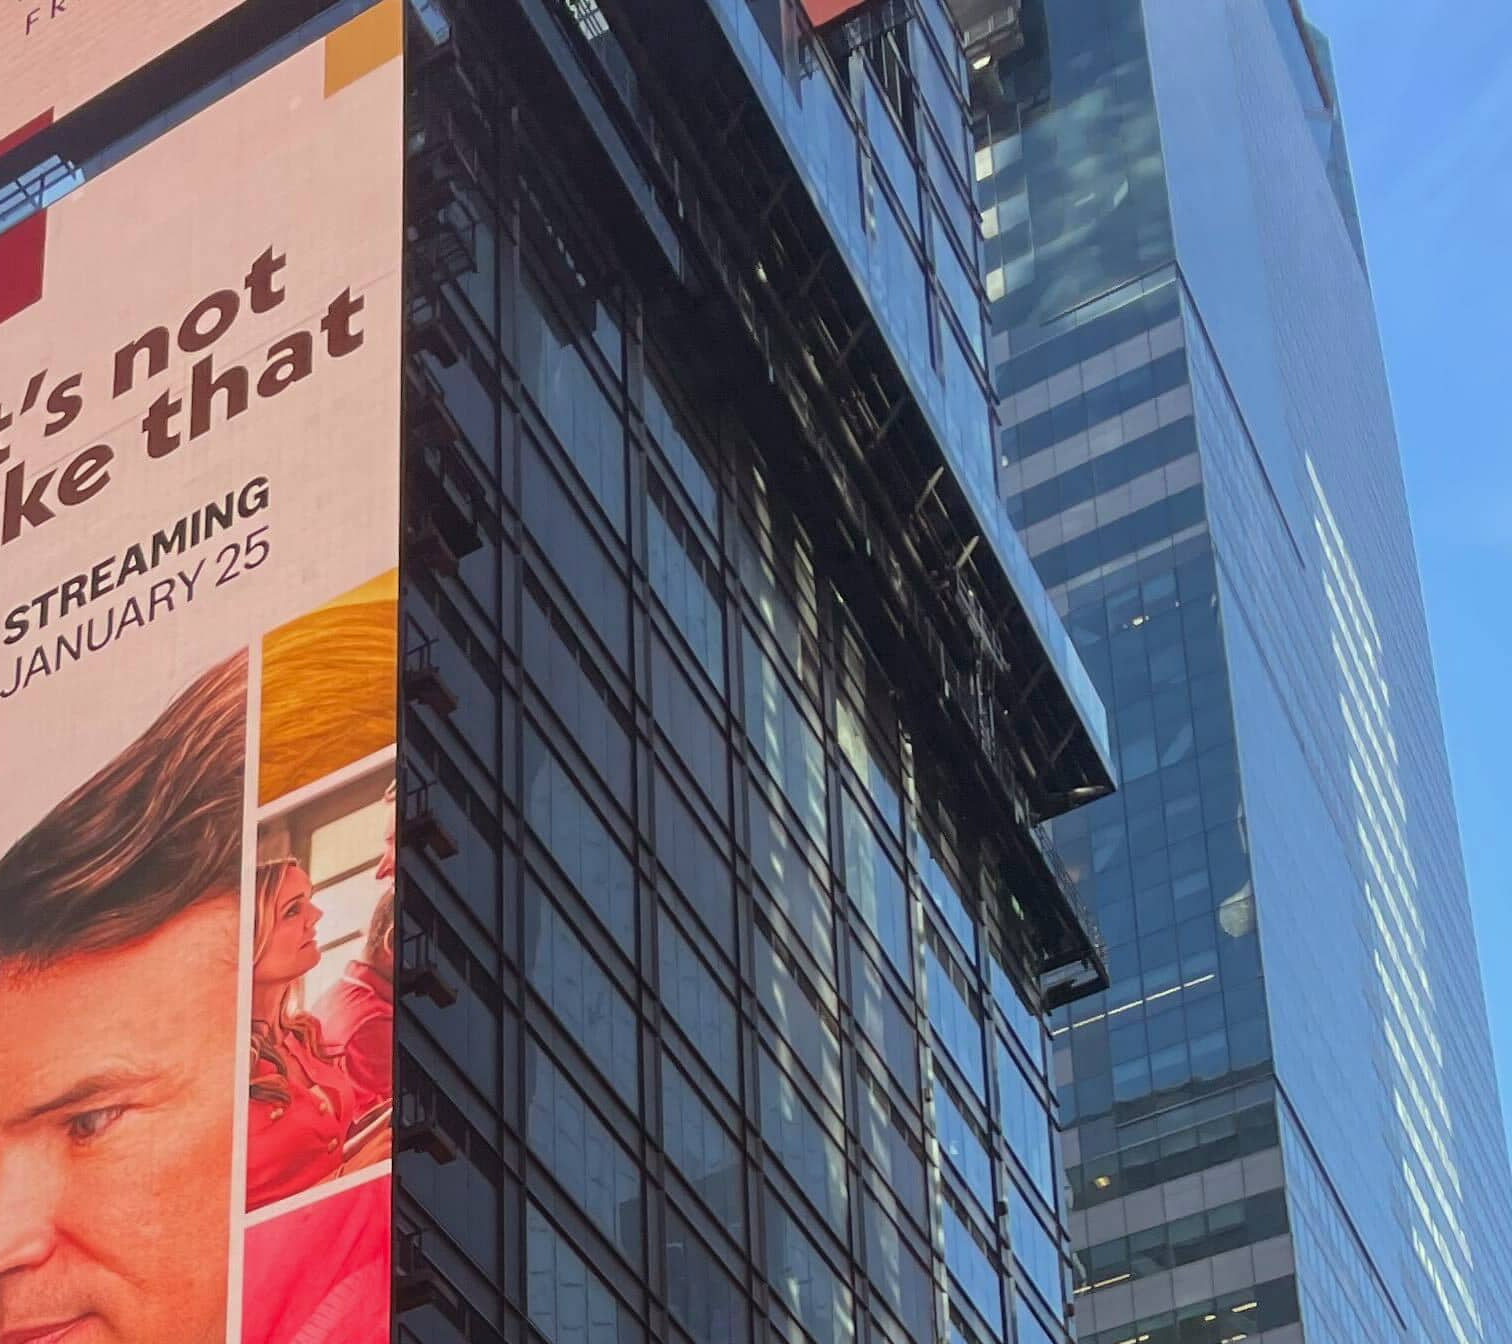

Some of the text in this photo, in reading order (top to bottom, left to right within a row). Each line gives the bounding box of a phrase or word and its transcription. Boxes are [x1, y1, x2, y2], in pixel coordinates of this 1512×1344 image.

[111, 244, 287, 398] not
[141, 285, 365, 460] that
[0, 525, 271, 698] JANUARY 25
[1, 476, 270, 646] STREAMING
